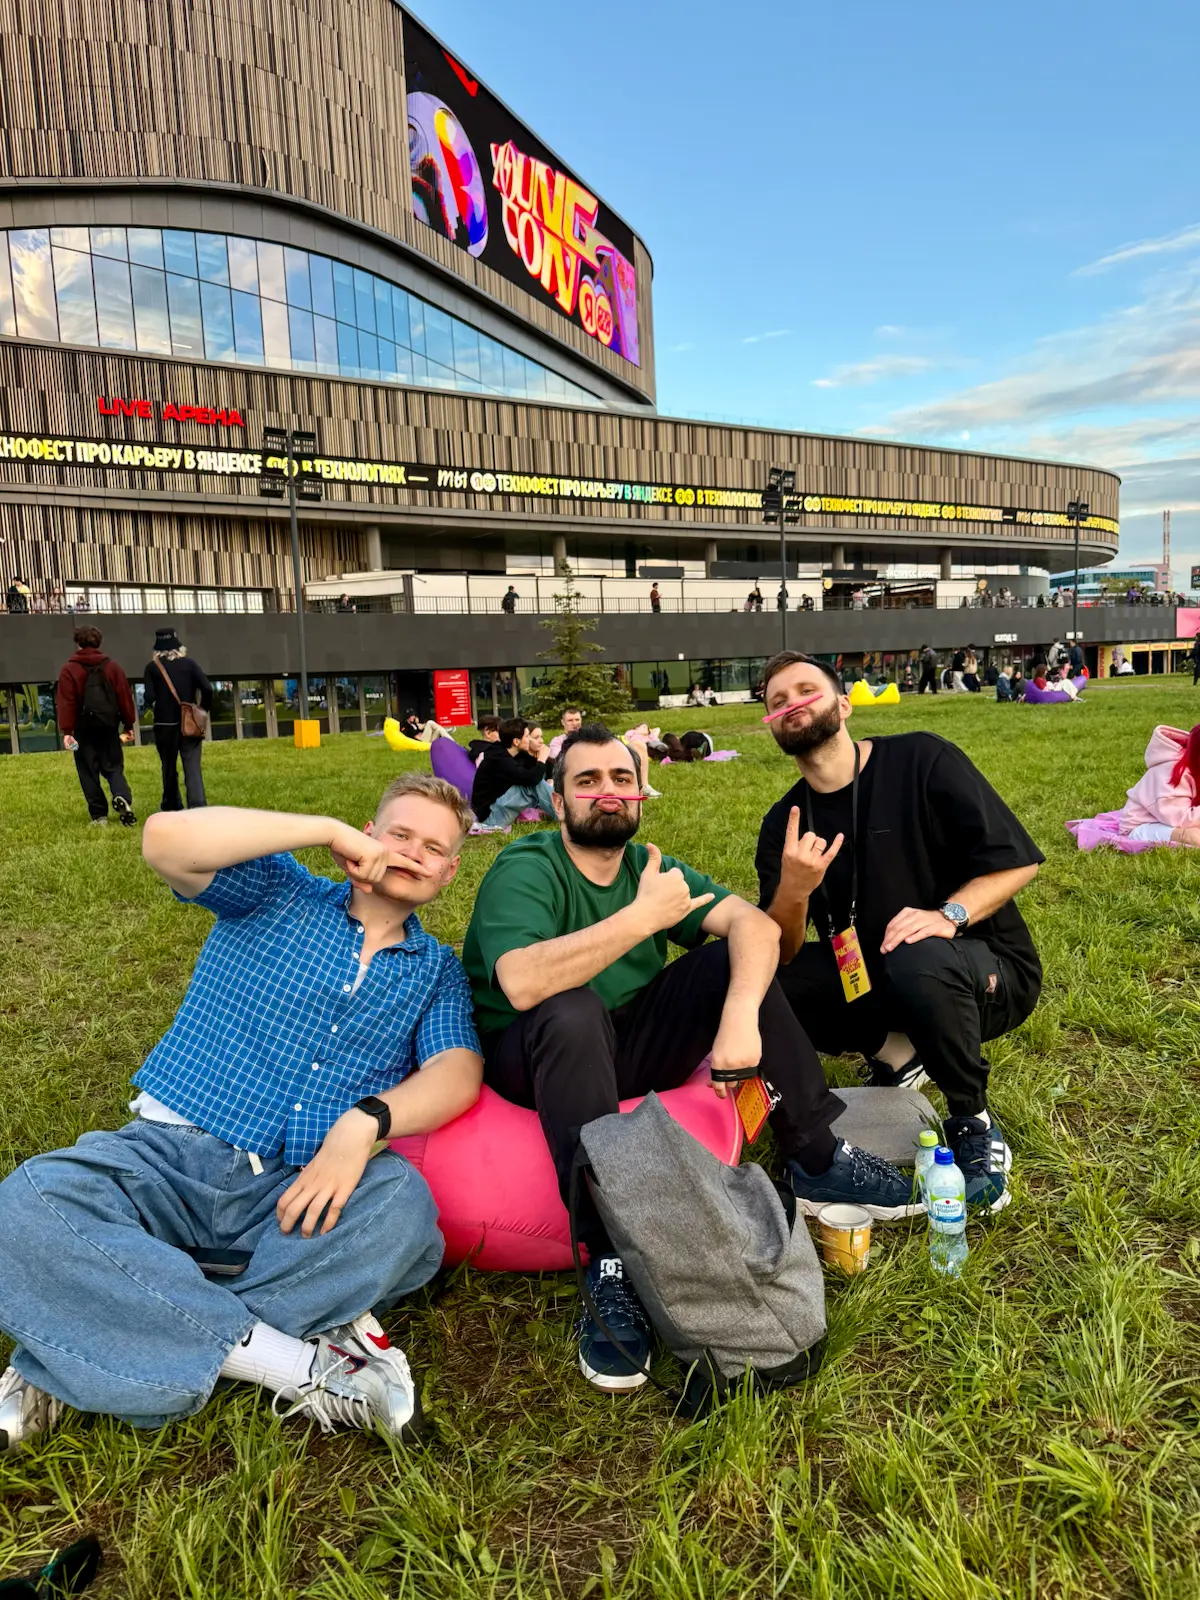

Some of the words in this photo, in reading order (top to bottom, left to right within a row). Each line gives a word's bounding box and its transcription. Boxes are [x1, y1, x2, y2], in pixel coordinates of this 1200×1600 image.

[489, 139, 610, 277] YOUNG
[499, 192, 580, 316] CON
[98, 397, 152, 419] LIVE
[163, 403, 244, 427] АРЕНА
[75, 442, 111, 464] ПРО
[112, 444, 183, 469] КАРЬЕРУ
[183, 449, 196, 470] В
[197, 450, 262, 475] ЯНДЕКСЕ
[314, 459, 407, 485] ТЕХНОЛОГИЯХ
[496, 473, 559, 495] ТЕХНОФЕСТ
[559, 479, 581, 497] ПРО
[581, 480, 623, 499] КАРЬЕРУ
[632, 485, 673, 504] ЯНДЕКСЕ
